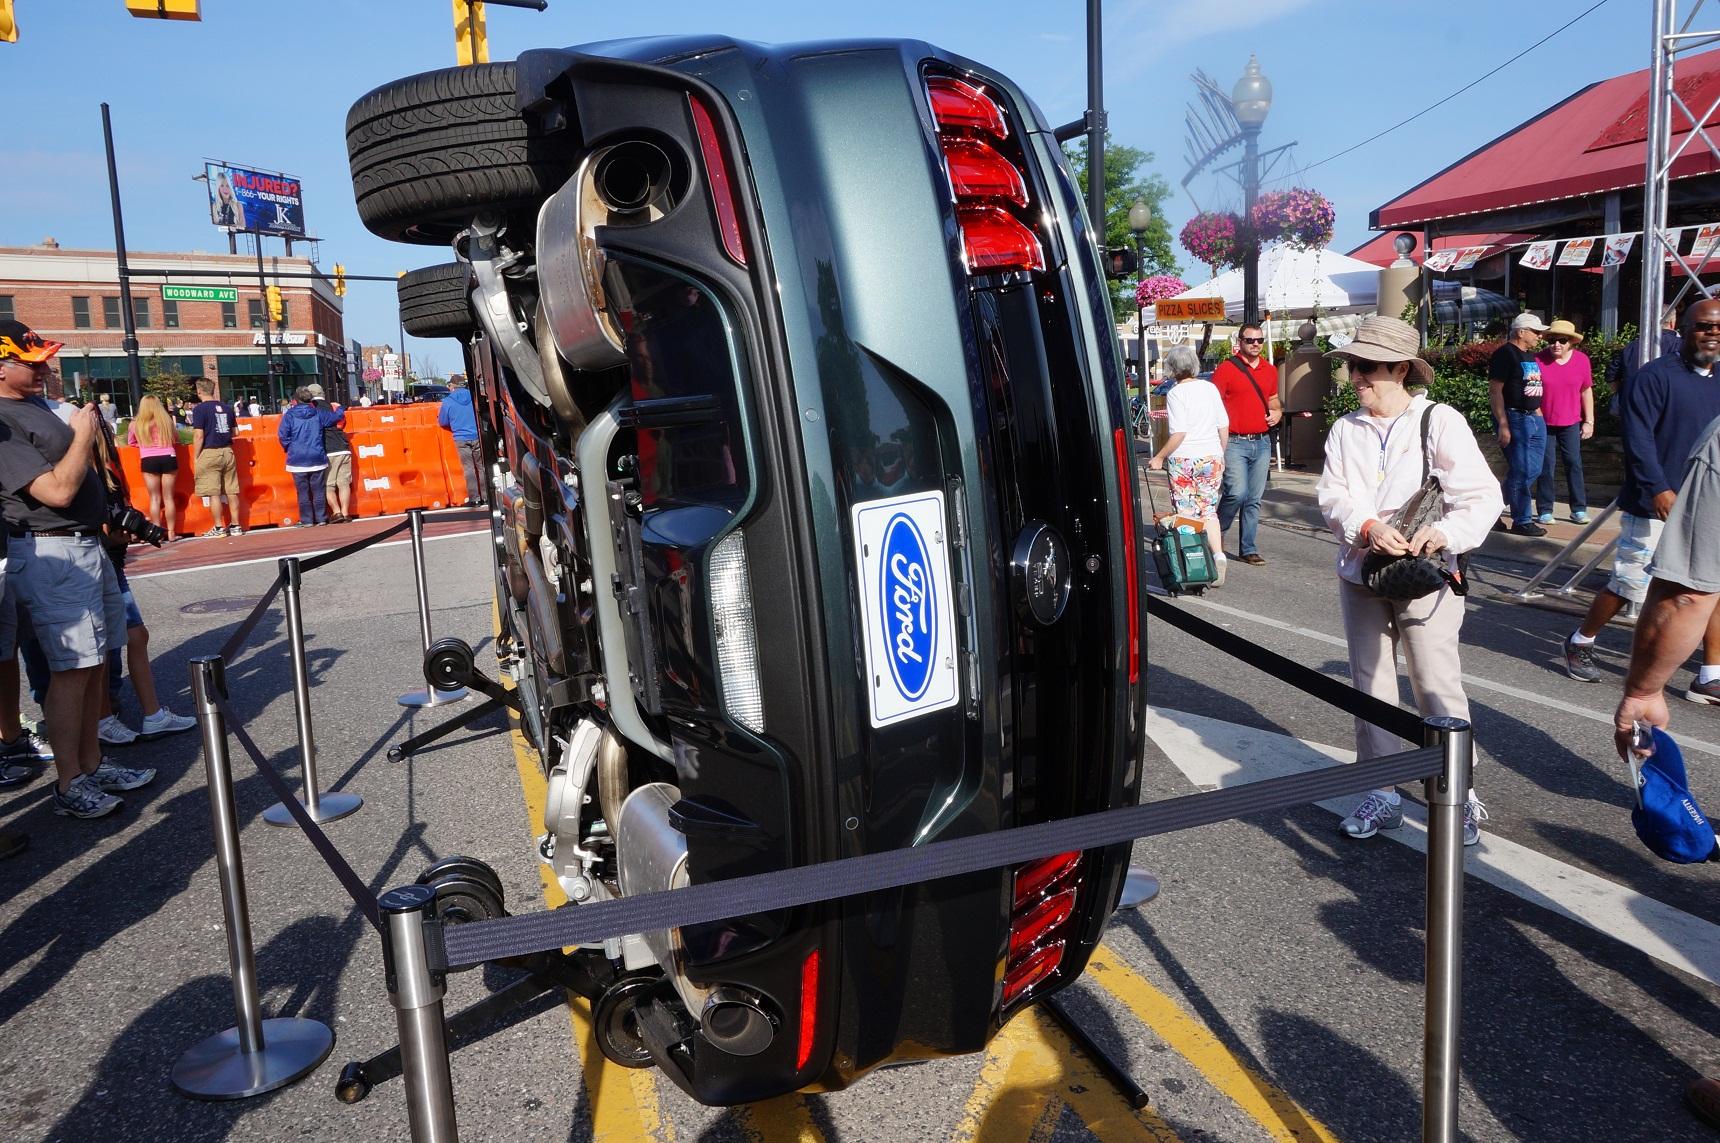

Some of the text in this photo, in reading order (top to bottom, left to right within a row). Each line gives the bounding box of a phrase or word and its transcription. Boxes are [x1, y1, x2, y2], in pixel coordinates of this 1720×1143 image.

[232, 173, 298, 197] INJURED?
[276, 194, 299, 206] RIGHTS
[273, 203, 291, 224] JK
[166, 288, 235, 299] WOODWARD AVE
[1158, 303, 1220, 316] PIZZA SLICES
[891, 553, 927, 664] Ford
[1680, 798, 1704, 825] HAGERTY
